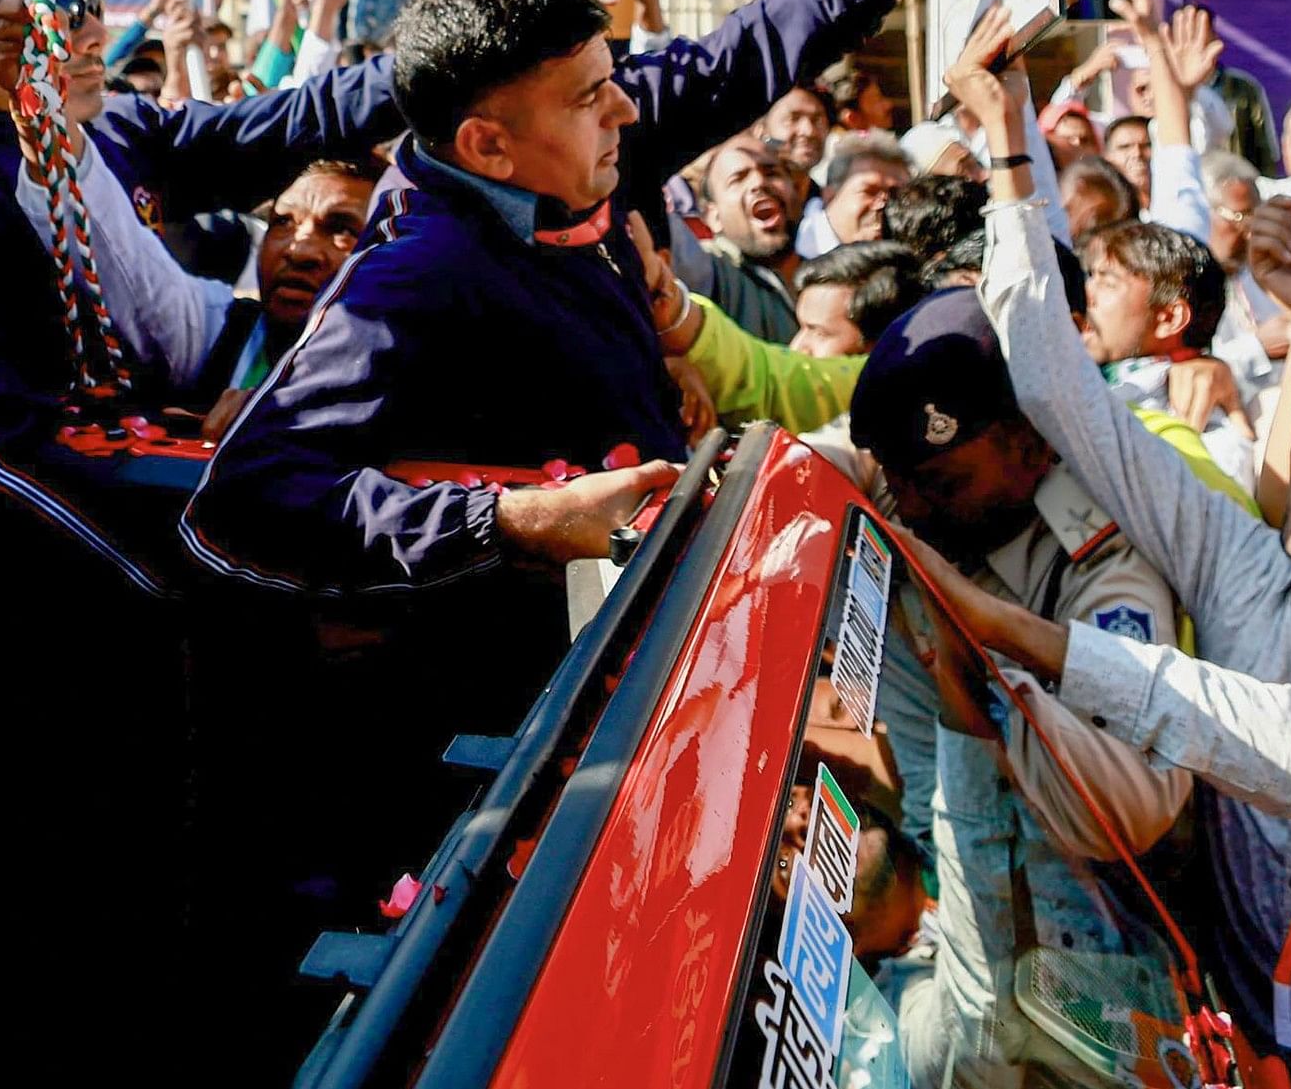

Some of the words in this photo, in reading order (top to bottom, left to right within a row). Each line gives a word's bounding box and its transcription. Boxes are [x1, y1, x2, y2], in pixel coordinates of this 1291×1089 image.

[835, 630, 873, 729] BHARAT
[847, 593, 878, 667] JODO
[810, 797, 852, 905] यात्रा
[790, 875, 840, 1019] न्याय
